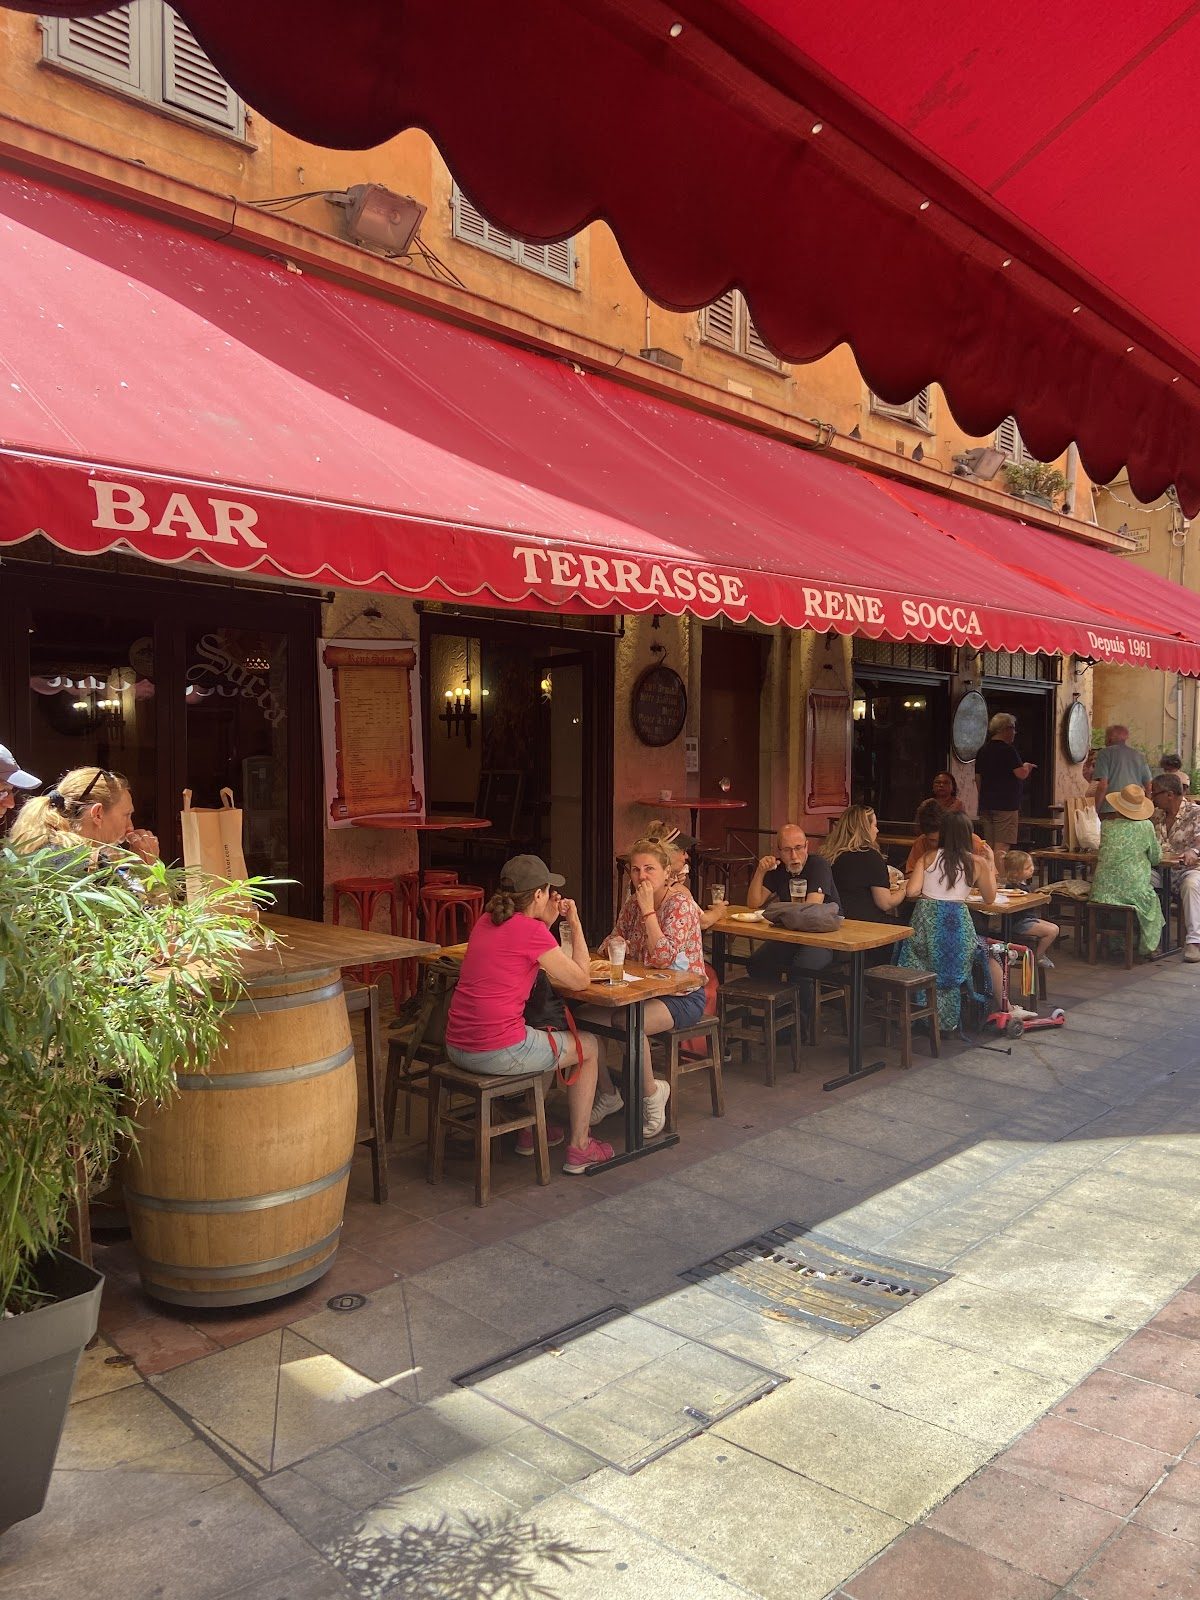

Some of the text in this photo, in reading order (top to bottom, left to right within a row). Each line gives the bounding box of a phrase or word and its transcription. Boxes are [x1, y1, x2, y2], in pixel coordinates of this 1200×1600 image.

[88, 479, 267, 549] BAR
[513, 547, 748, 606] TERRASSE
[802, 587, 982, 636] RENE SOCCA
[1087, 631, 1152, 658] Depuis 1961
